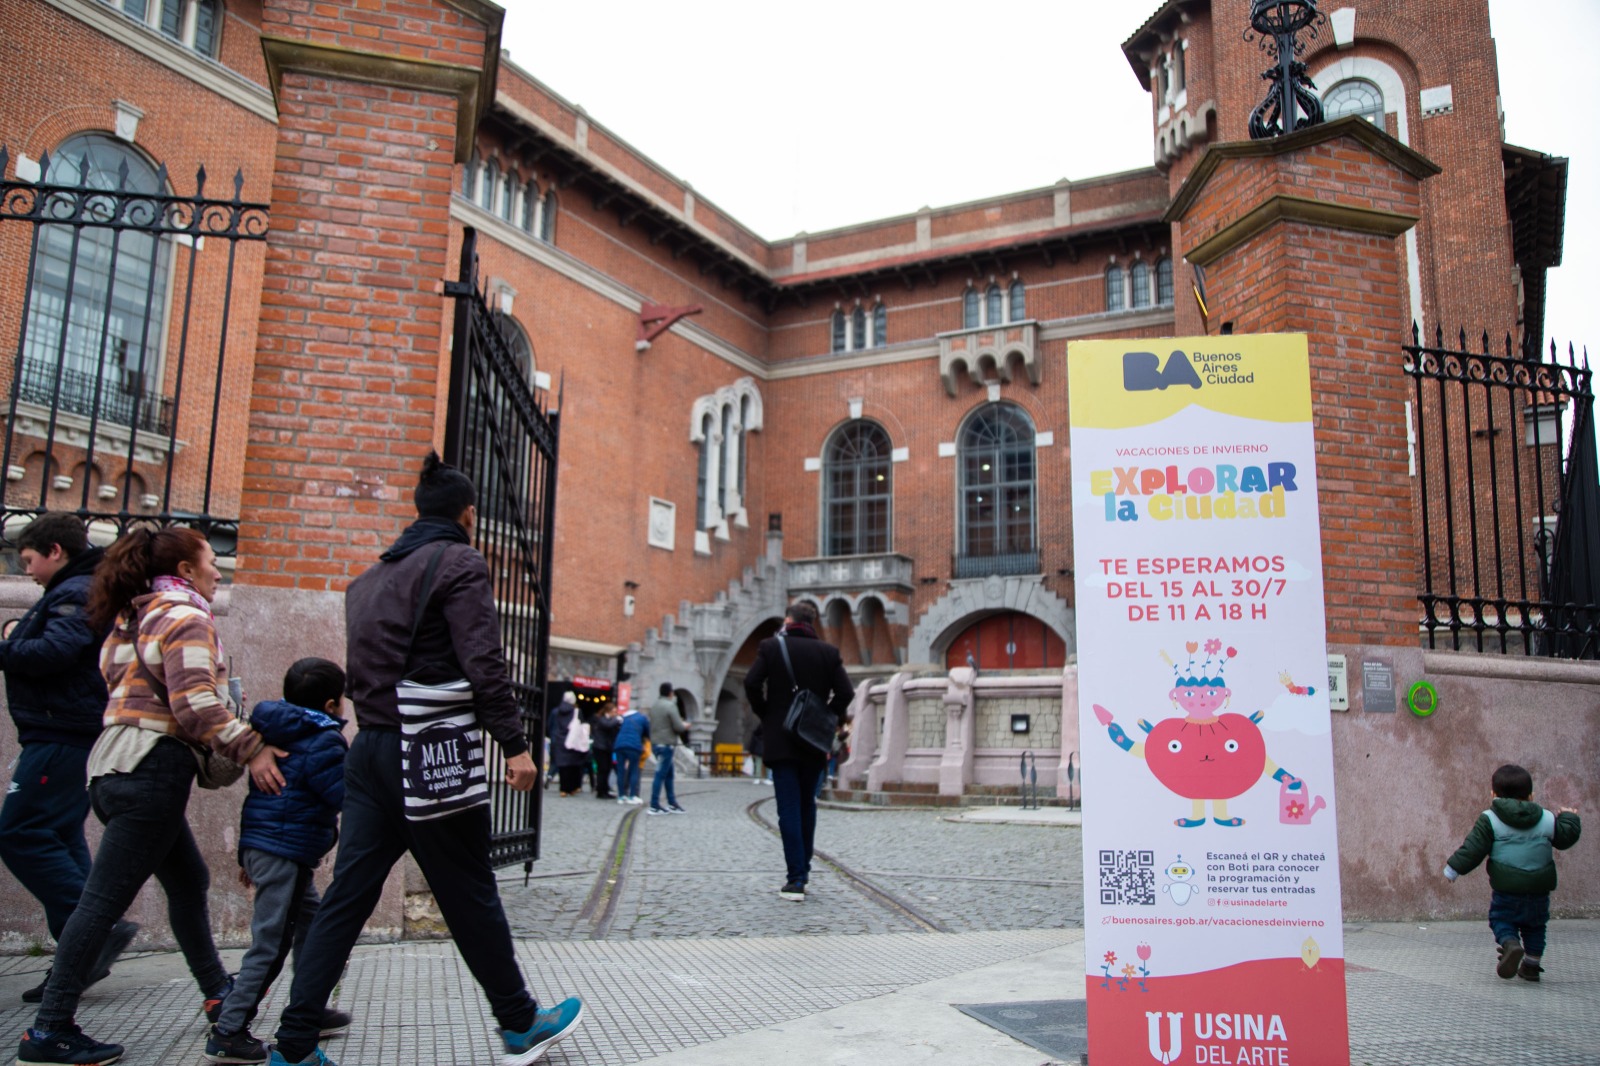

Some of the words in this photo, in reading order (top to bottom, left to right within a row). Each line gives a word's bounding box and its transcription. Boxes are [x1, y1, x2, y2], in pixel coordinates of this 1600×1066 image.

[1193, 352, 1241, 362] Buenos
[1123, 350, 1202, 391] BA
[1202, 363, 1238, 373] Aires
[1206, 372, 1254, 384] Ciudad
[1116, 447, 1190, 457] VACACIONES
[1193, 446, 1209, 454] DE
[1212, 444, 1269, 454] INVIERNO
[1090, 462, 1298, 496] EXPLORAR
[1104, 491, 1138, 522] la
[1099, 559, 1128, 575] TE
[1137, 556, 1285, 575] ESPERAMOS
[1107, 582, 1153, 598] DEL
[1160, 581, 1183, 598] 15
[1192, 580, 1223, 597] AL
[1231, 577, 1287, 599] 30/7
[1128, 605, 1159, 621] DE
[1168, 604, 1185, 621] 11
[1194, 604, 1211, 620] A
[1219, 603, 1243, 620] 18
[1251, 603, 1267, 620] H
[422, 739, 461, 767] MATE
[423, 770, 431, 780] IS
[434, 778, 448, 793] good
[1206, 852, 1248, 860] Escaneá
[1251, 852, 1260, 860] el
[1263, 852, 1279, 861] QR
[1282, 854, 1288, 862] y
[1291, 852, 1325, 861] chateá
[1228, 863, 1249, 871] Boti
[1252, 865, 1275, 873] para
[1278, 864, 1320, 872] conocer
[1207, 874, 1216, 882] la
[1219, 874, 1291, 884] programación
[1293, 876, 1300, 884] y
[1271, 886, 1316, 894] entradas
[1112, 916, 1325, 927] buenosaires.gob.ar/vacacionesdeinvierno
[1194, 1013, 1288, 1041] USINA
[1195, 1045, 1231, 1064] DEL
[1236, 1046, 1289, 1066] ARTE
